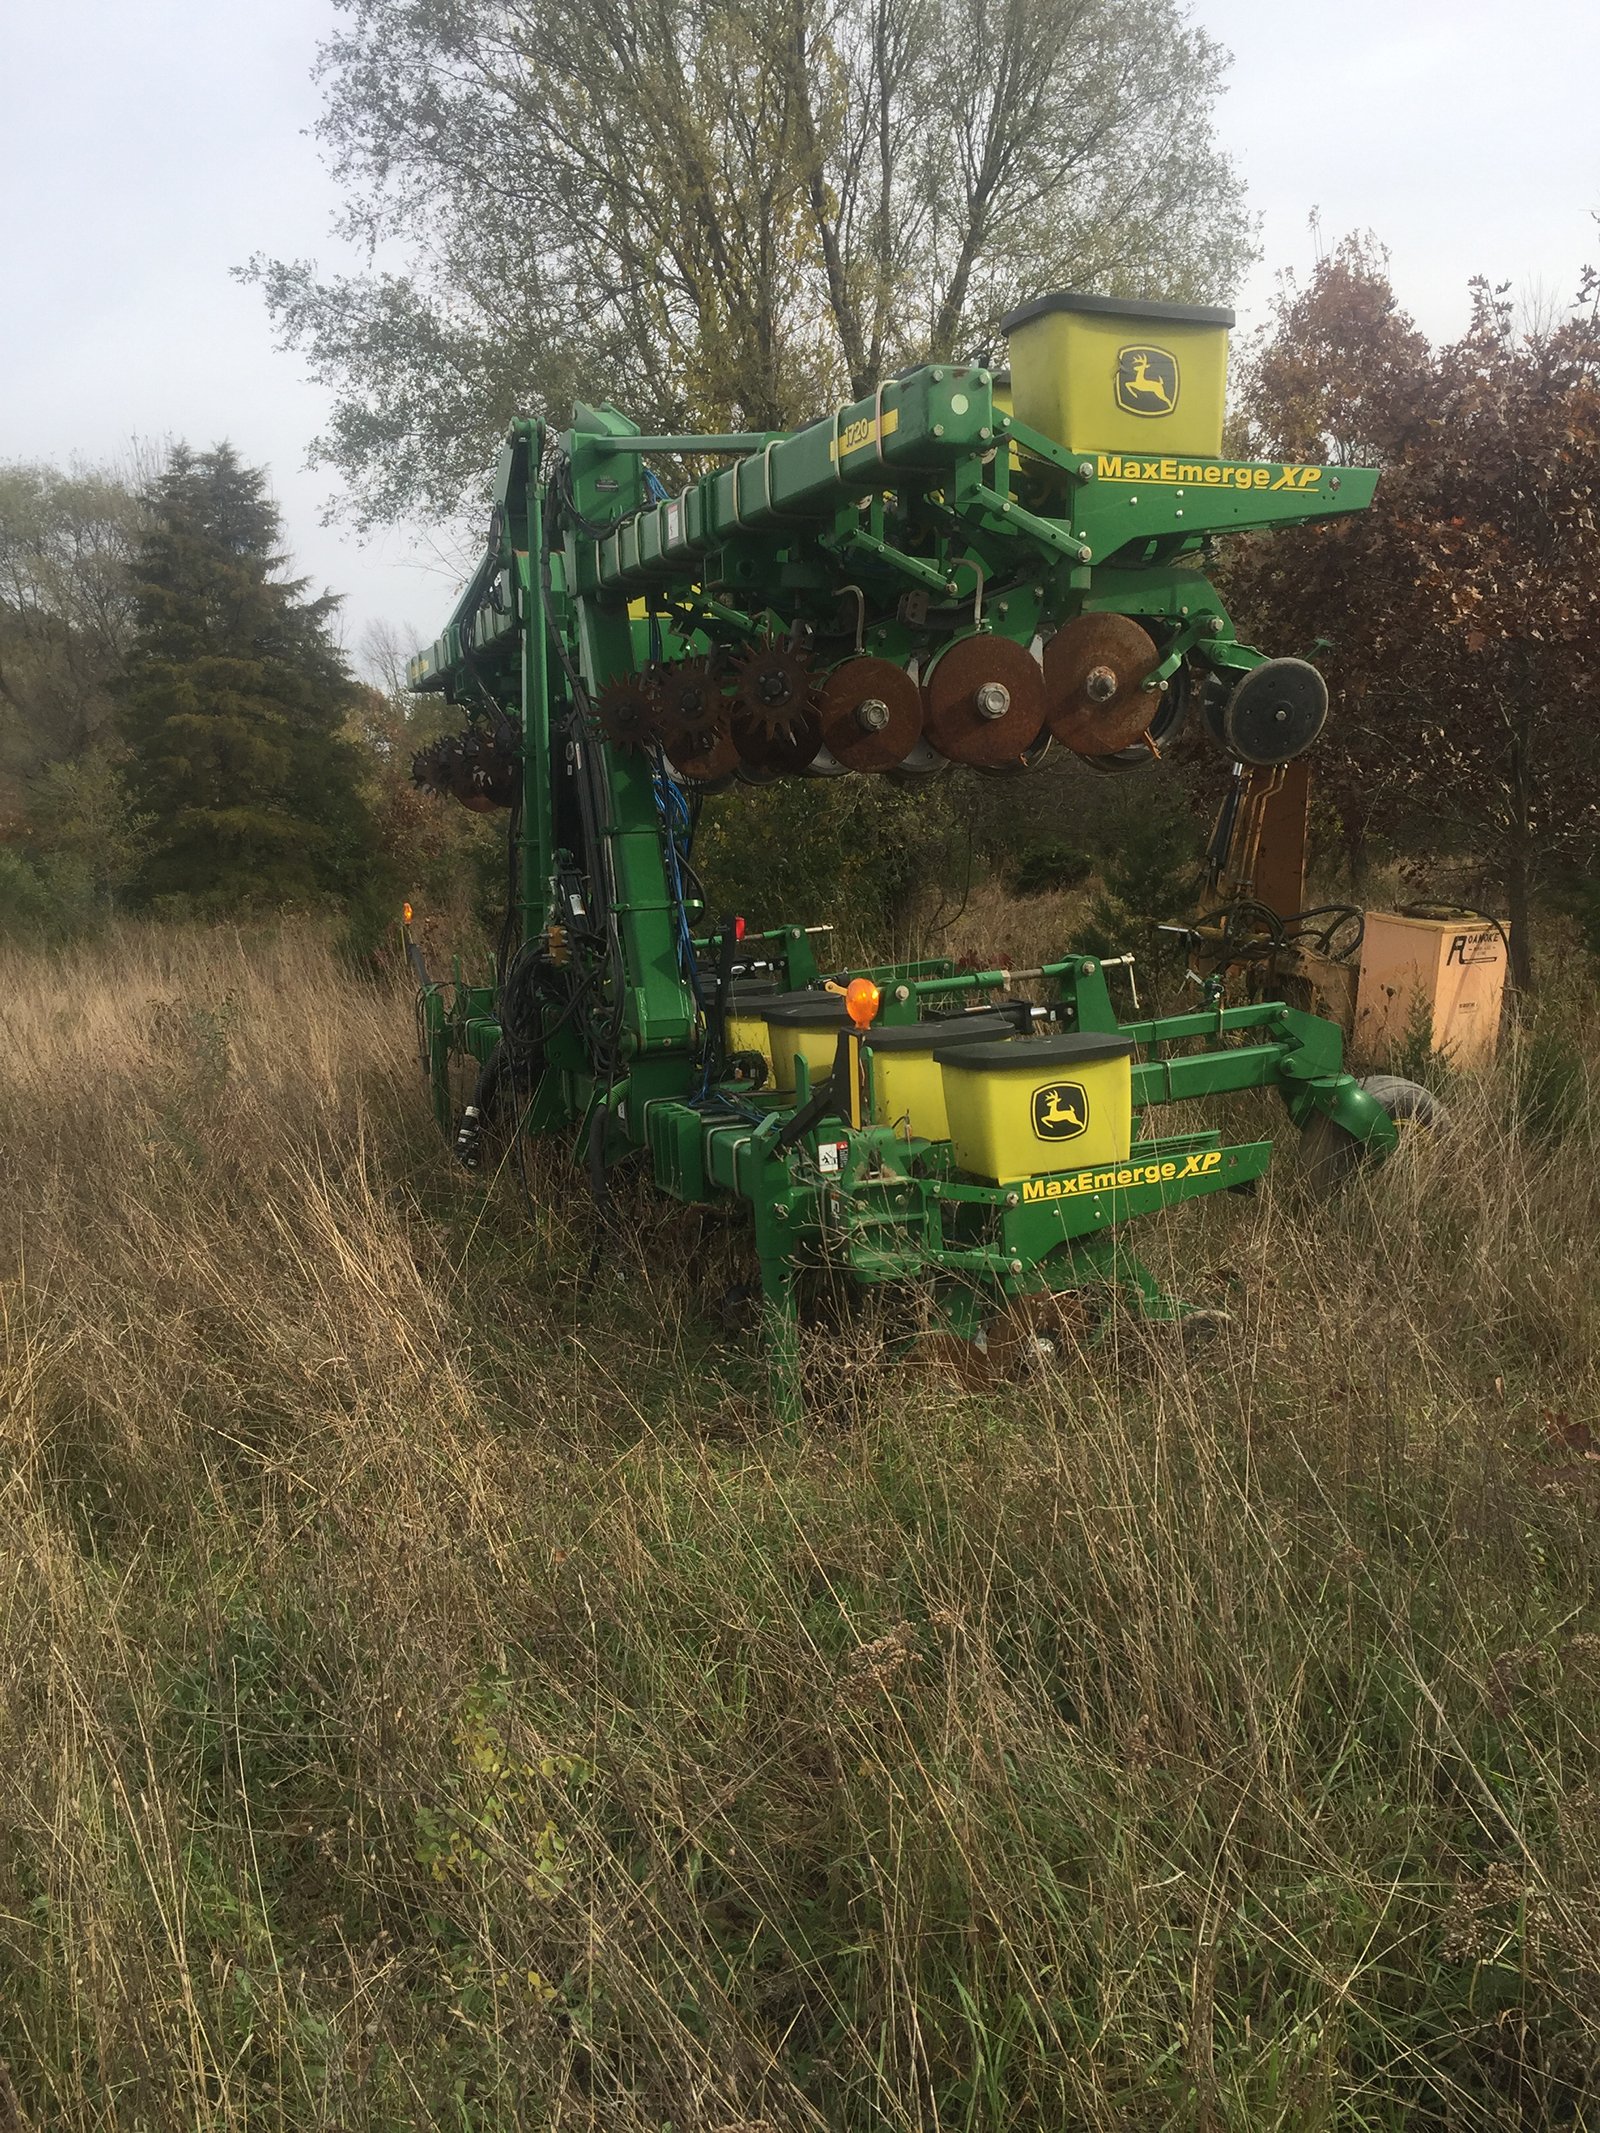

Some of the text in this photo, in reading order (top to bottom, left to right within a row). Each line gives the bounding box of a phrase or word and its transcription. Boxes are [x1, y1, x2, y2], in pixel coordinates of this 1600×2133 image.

[843, 418, 868, 447] 1720
[1097, 456, 1322, 490] MaxEmerge XP
[1022, 1152, 1221, 1200] MaxEmerge XP
